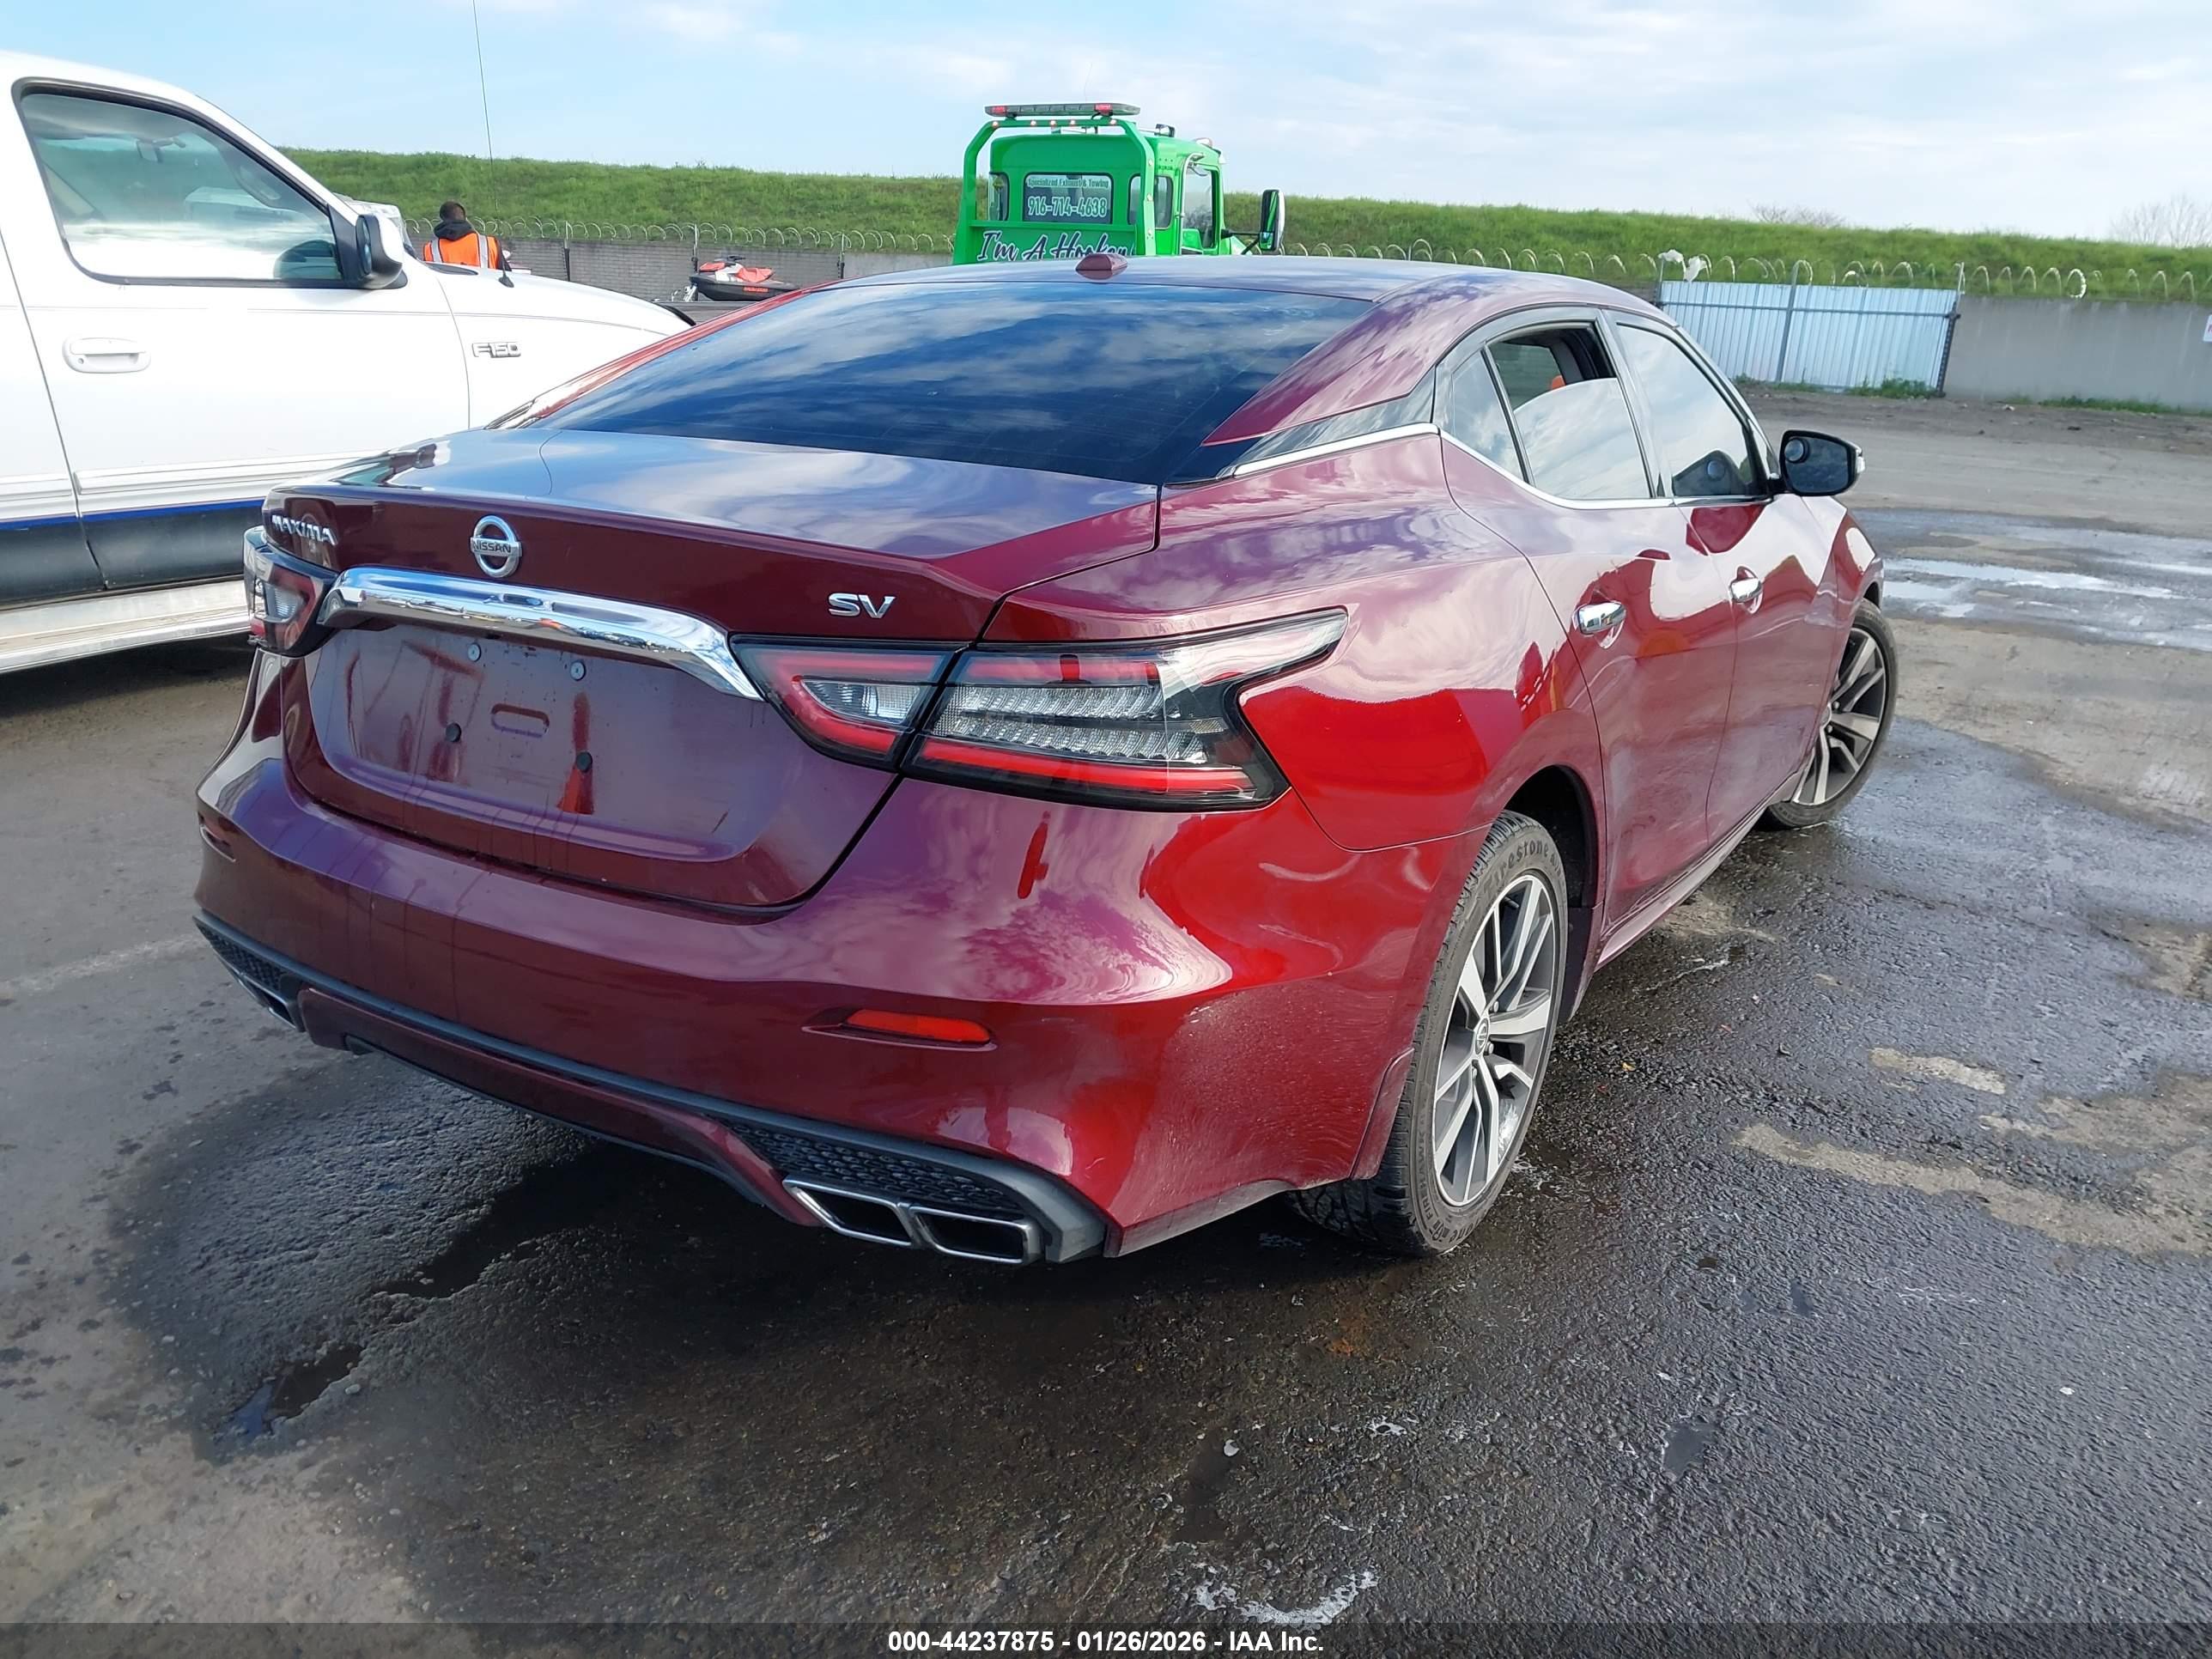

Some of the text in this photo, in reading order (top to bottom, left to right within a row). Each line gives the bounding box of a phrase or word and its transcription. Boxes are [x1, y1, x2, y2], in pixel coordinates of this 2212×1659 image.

[1028, 196, 1108, 217] 916-714-4638
[977, 230, 1018, 261] I'm
[1023, 234, 1048, 261] A
[271, 514, 337, 546] MAXIMA
[472, 540, 512, 553] NISSAN
[828, 592, 896, 619] SV
